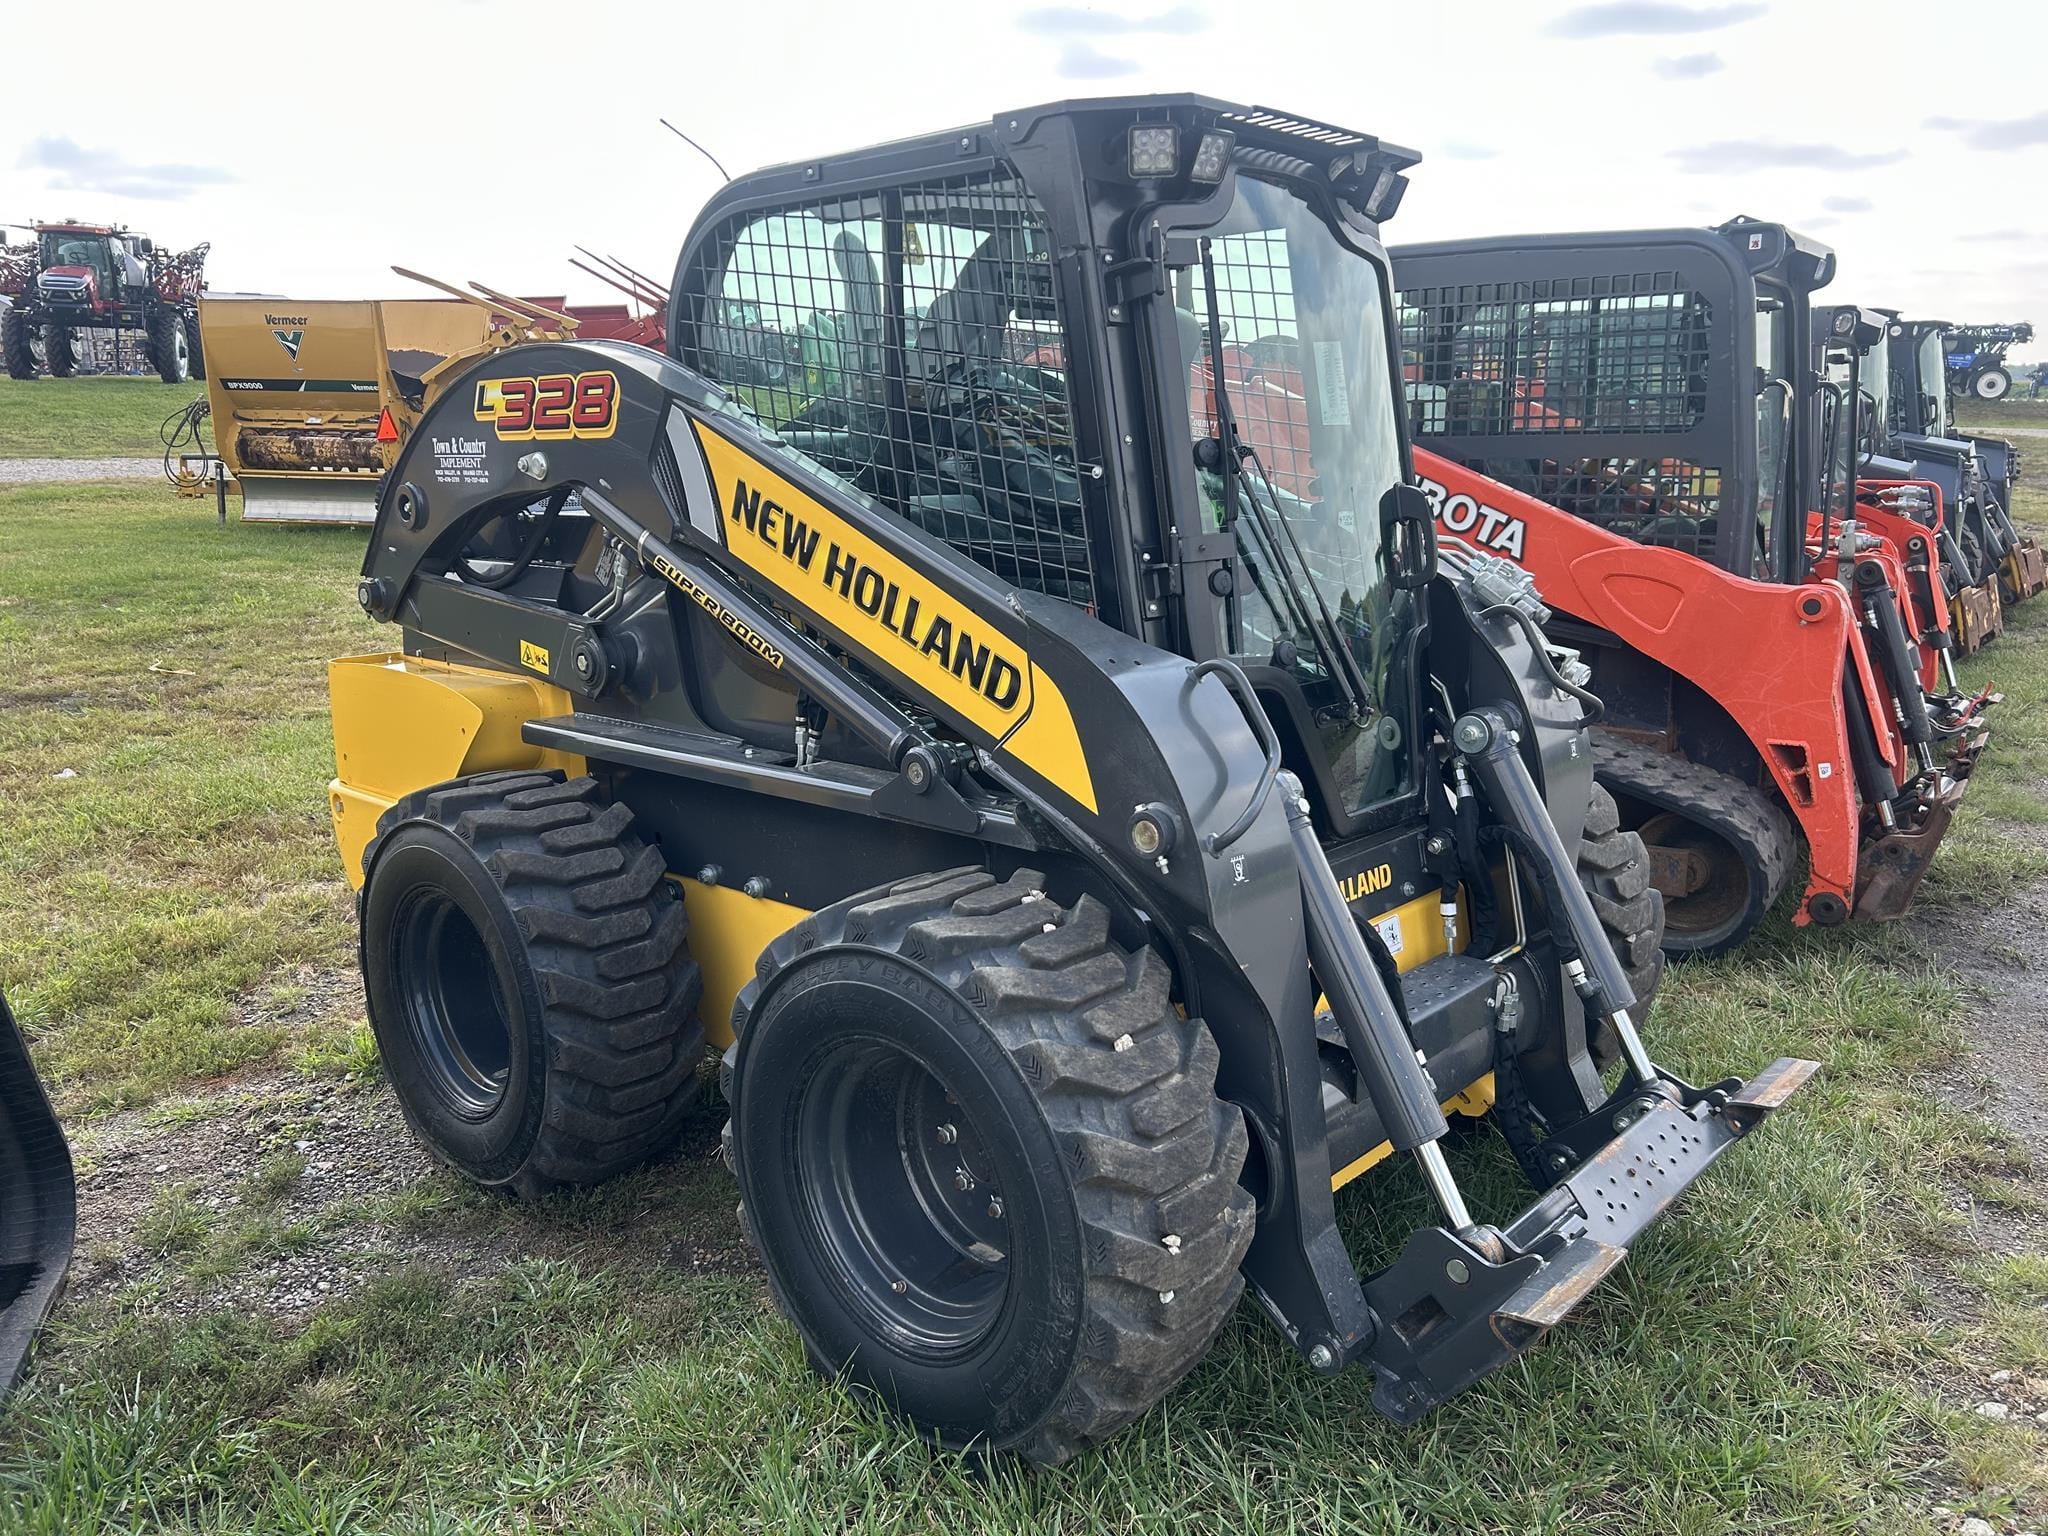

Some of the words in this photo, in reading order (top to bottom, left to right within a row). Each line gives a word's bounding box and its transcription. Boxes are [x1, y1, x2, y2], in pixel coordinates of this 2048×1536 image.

[264, 314, 308, 326] Vermeer
[227, 382, 264, 390] BPX9000
[474, 370, 621, 440] L328
[432, 437, 451, 454] Town
[451, 437, 458, 454] &
[459, 437, 487, 457] Country
[440, 458, 481, 468] IMPLEMENT
[1415, 474, 1525, 560] BOTA
[653, 555, 720, 618] SUPER
[719, 609, 784, 669] BOOM
[730, 477, 822, 572] NEW
[822, 541, 1022, 711] HOLLAND
[879, 963, 974, 1027] BABY
